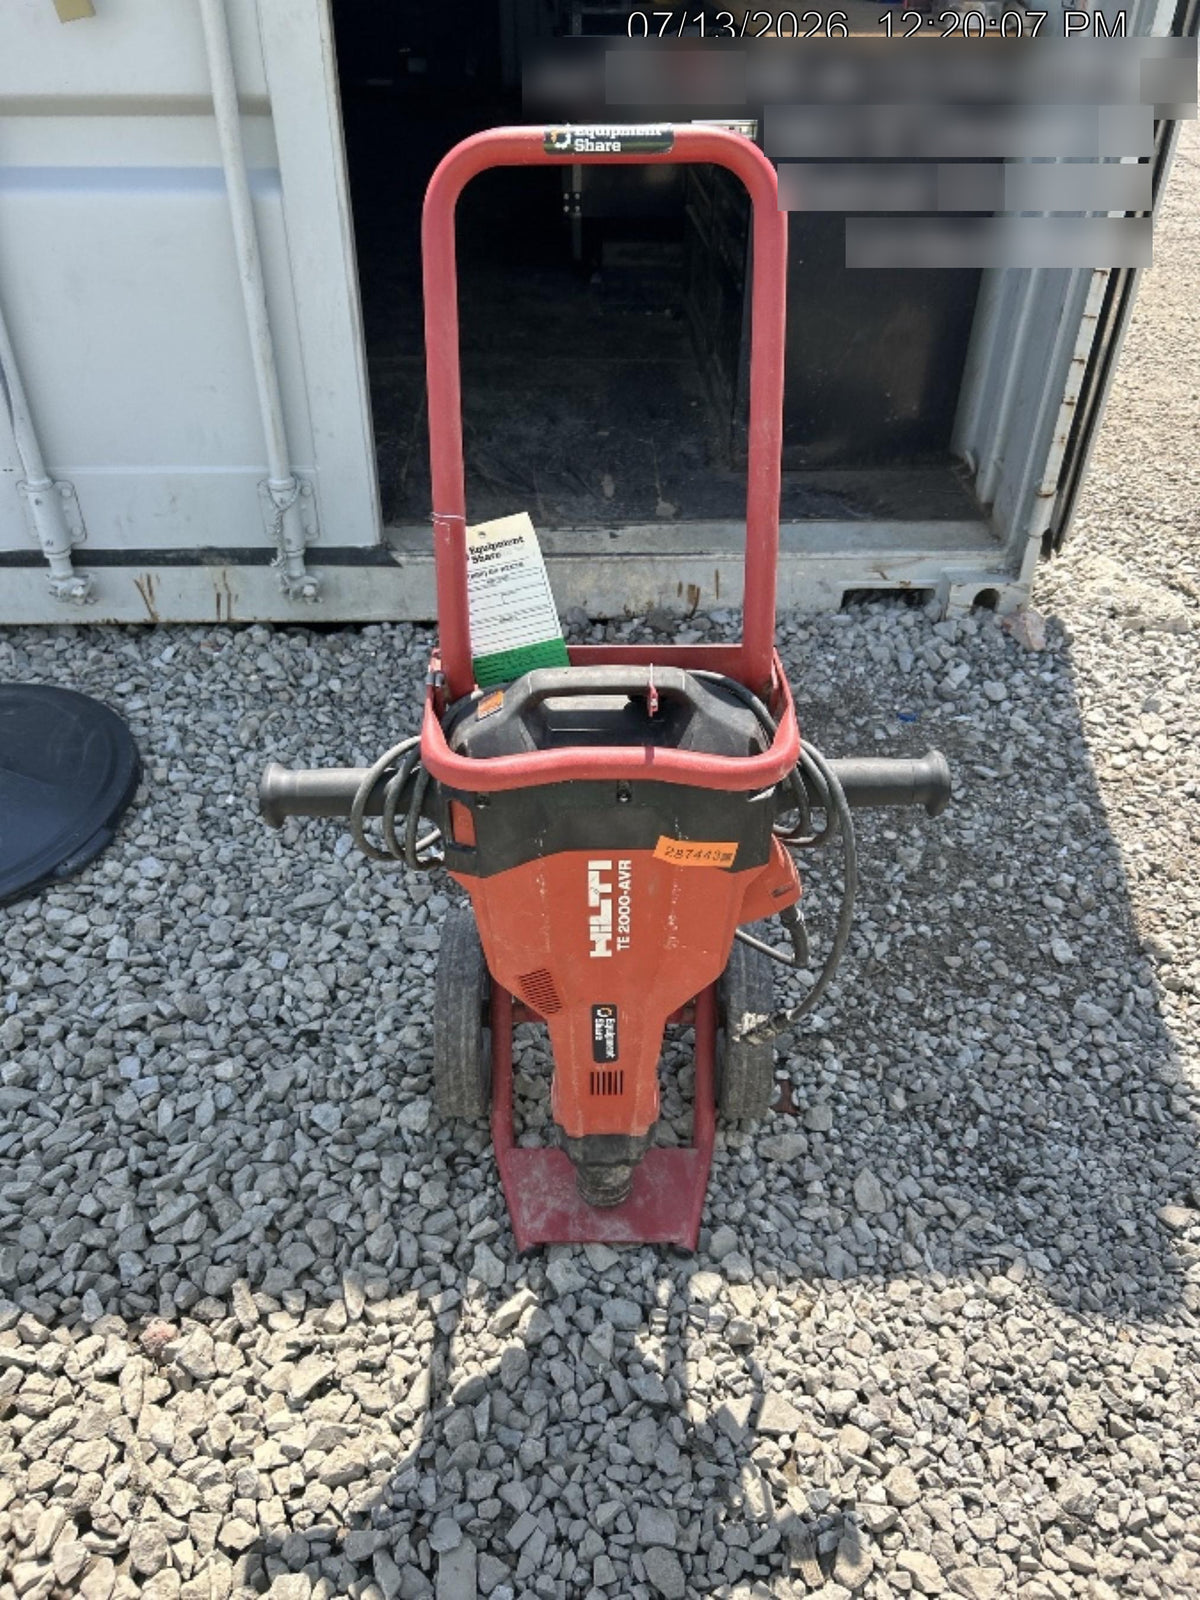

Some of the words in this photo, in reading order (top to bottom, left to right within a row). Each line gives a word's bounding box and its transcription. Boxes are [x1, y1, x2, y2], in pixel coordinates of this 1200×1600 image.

[574, 138, 621, 152] Share
[588, 860, 612, 957] HILTI
[618, 860, 632, 934] 2000-AVR
[617, 936, 630, 951] TE
[604, 1018, 616, 1059] Equipment
